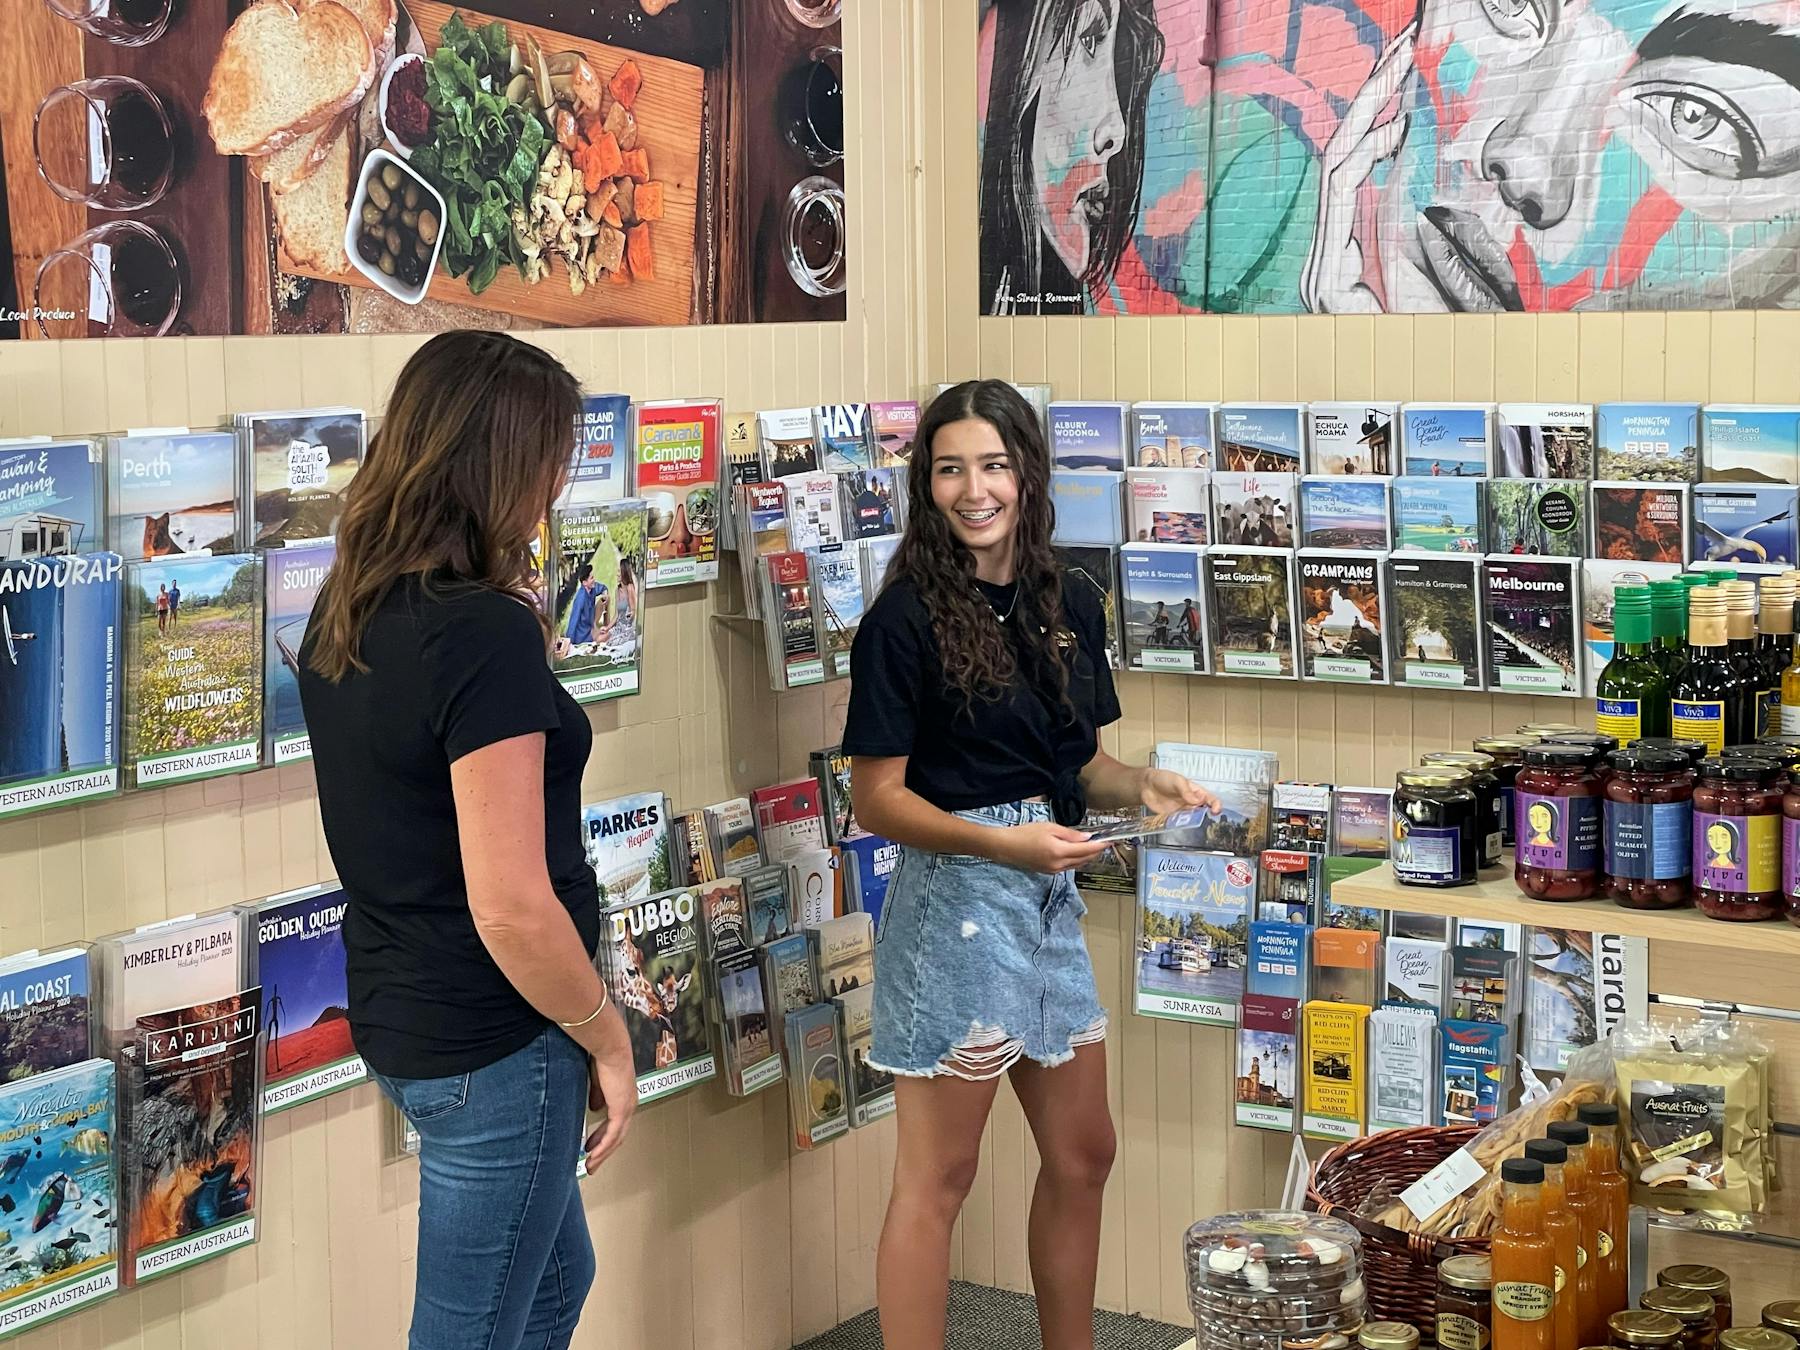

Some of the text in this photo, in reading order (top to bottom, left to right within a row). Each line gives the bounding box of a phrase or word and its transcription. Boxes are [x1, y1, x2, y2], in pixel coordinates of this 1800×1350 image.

[0, 306, 75, 321] Local Produce
[820, 402, 866, 438] HAY
[1411, 415, 1439, 429] Great
[1623, 415, 1670, 426] MORNINGTON
[644, 423, 701, 442] Caravan &
[1055, 429, 1100, 437] WODONGA
[1416, 424, 1446, 438] Ocean
[1627, 425, 1666, 436] PENINSULA
[1711, 426, 1734, 434] Phillip
[1417, 430, 1449, 447] Road
[292, 445, 304, 453] the
[643, 442, 701, 463] Camping
[123, 452, 171, 478] Perth
[291, 453, 323, 463] AMAZING
[659, 462, 701, 471] Parks Products
[659, 473, 676, 481] Holiday
[750, 485, 784, 498] Wentworth
[1243, 478, 1261, 494] Life
[1134, 490, 1167, 498] Heathcote
[1311, 495, 1335, 504] Geelong
[757, 496, 779, 508] Region
[1649, 503, 1678, 511] WENTWORTH
[562, 515, 601, 526] SOUTHERN
[1541, 510, 1573, 518] KOONDROOK
[1651, 511, 1678, 519] SURROUNDS
[562, 525, 608, 537] QUEENSLAND
[562, 537, 596, 547] COUNTRY
[839, 561, 855, 570] HILL
[1304, 563, 1373, 579] GRAMPIANS
[283, 568, 324, 590] SOUTH
[1128, 569, 1149, 578] Bright
[1157, 571, 1193, 579] Surrounds
[1214, 572, 1272, 583] East Gippsland
[1395, 579, 1425, 588] Hamilton
[1432, 580, 1467, 590] Grampians
[1489, 576, 1565, 592] Melbourne
[168, 646, 195, 662] GUIDE
[1154, 656, 1181, 664] VICTORIA
[1237, 659, 1266, 667] VICTORIA
[1327, 665, 1357, 673] VICTORIA
[164, 663, 205, 678] Western
[1419, 670, 1450, 679] VICTORIA
[1514, 674, 1547, 683] VICTORIA
[567, 676, 622, 697] QUEENSLAND
[164, 688, 244, 713] WILDFLOWERS
[1603, 703, 1622, 714] viva
[1683, 706, 1704, 717] viva
[143, 748, 252, 775] WESTERN AUSTRALIA
[1182, 752, 1270, 784] WIMMERA
[48, 774, 111, 797] AUSTRALIA
[1340, 804, 1366, 816] Geelong
[590, 805, 659, 840] PARKES
[1341, 816, 1353, 824] The
[626, 827, 654, 849] Region
[1615, 841, 1648, 849] KALAMATA
[1523, 845, 1562, 859] viva
[1158, 858, 1204, 874] Welcome!
[1271, 863, 1287, 871] Shire
[1231, 867, 1248, 881] FREE
[1416, 872, 1432, 880] Fruit
[1703, 868, 1744, 881] viva
[1203, 879, 1248, 906] News
[1307, 877, 1315, 906] TOURING
[711, 897, 740, 920] Explore
[609, 892, 695, 943] DUBBO
[711, 914, 743, 931] HERITAGE
[258, 915, 304, 944] GOLDEN
[300, 923, 341, 941] Holiday Planner
[725, 923, 740, 931] TRAIL
[655, 924, 696, 947] REGION
[1257, 935, 1298, 946] MORNINGTON
[124, 931, 233, 971] KIMBERLEY & PILBARA
[828, 943, 840, 954] Blue
[1261, 944, 1295, 956] PENINSULA
[1396, 949, 1422, 961] Great
[177, 947, 233, 969] Holiday Planner 2020
[1400, 959, 1430, 970] Ocean
[1400, 967, 1432, 980] Road
[25, 974, 71, 1006] COAST
[6, 997, 71, 1022] Holiday Planner 2020
[1163, 1000, 1222, 1016] SUNRAYSIA
[152, 1015, 252, 1055] KARIJINI
[1383, 1023, 1418, 1048] MILLEWA
[188, 1043, 221, 1058] and beyond
[637, 1061, 713, 1095] NEW SOUTH WALES
[744, 1063, 781, 1084] NEW SOUTH WALES
[264, 1063, 362, 1105] WESTERN AUSTRALIA
[88, 1098, 108, 1116] BAY
[1645, 1098, 1708, 1114] Ausnat Fruits
[1249, 1112, 1279, 1122] VICTORIA
[1317, 1122, 1347, 1132] VICTORIA
[141, 1225, 250, 1271] WESTERN AUSTRALIA
[49, 1275, 112, 1308] AUSTRALIA
[1497, 1285, 1528, 1294] Ausnat
[1502, 1300, 1529, 1309] APRICOT
